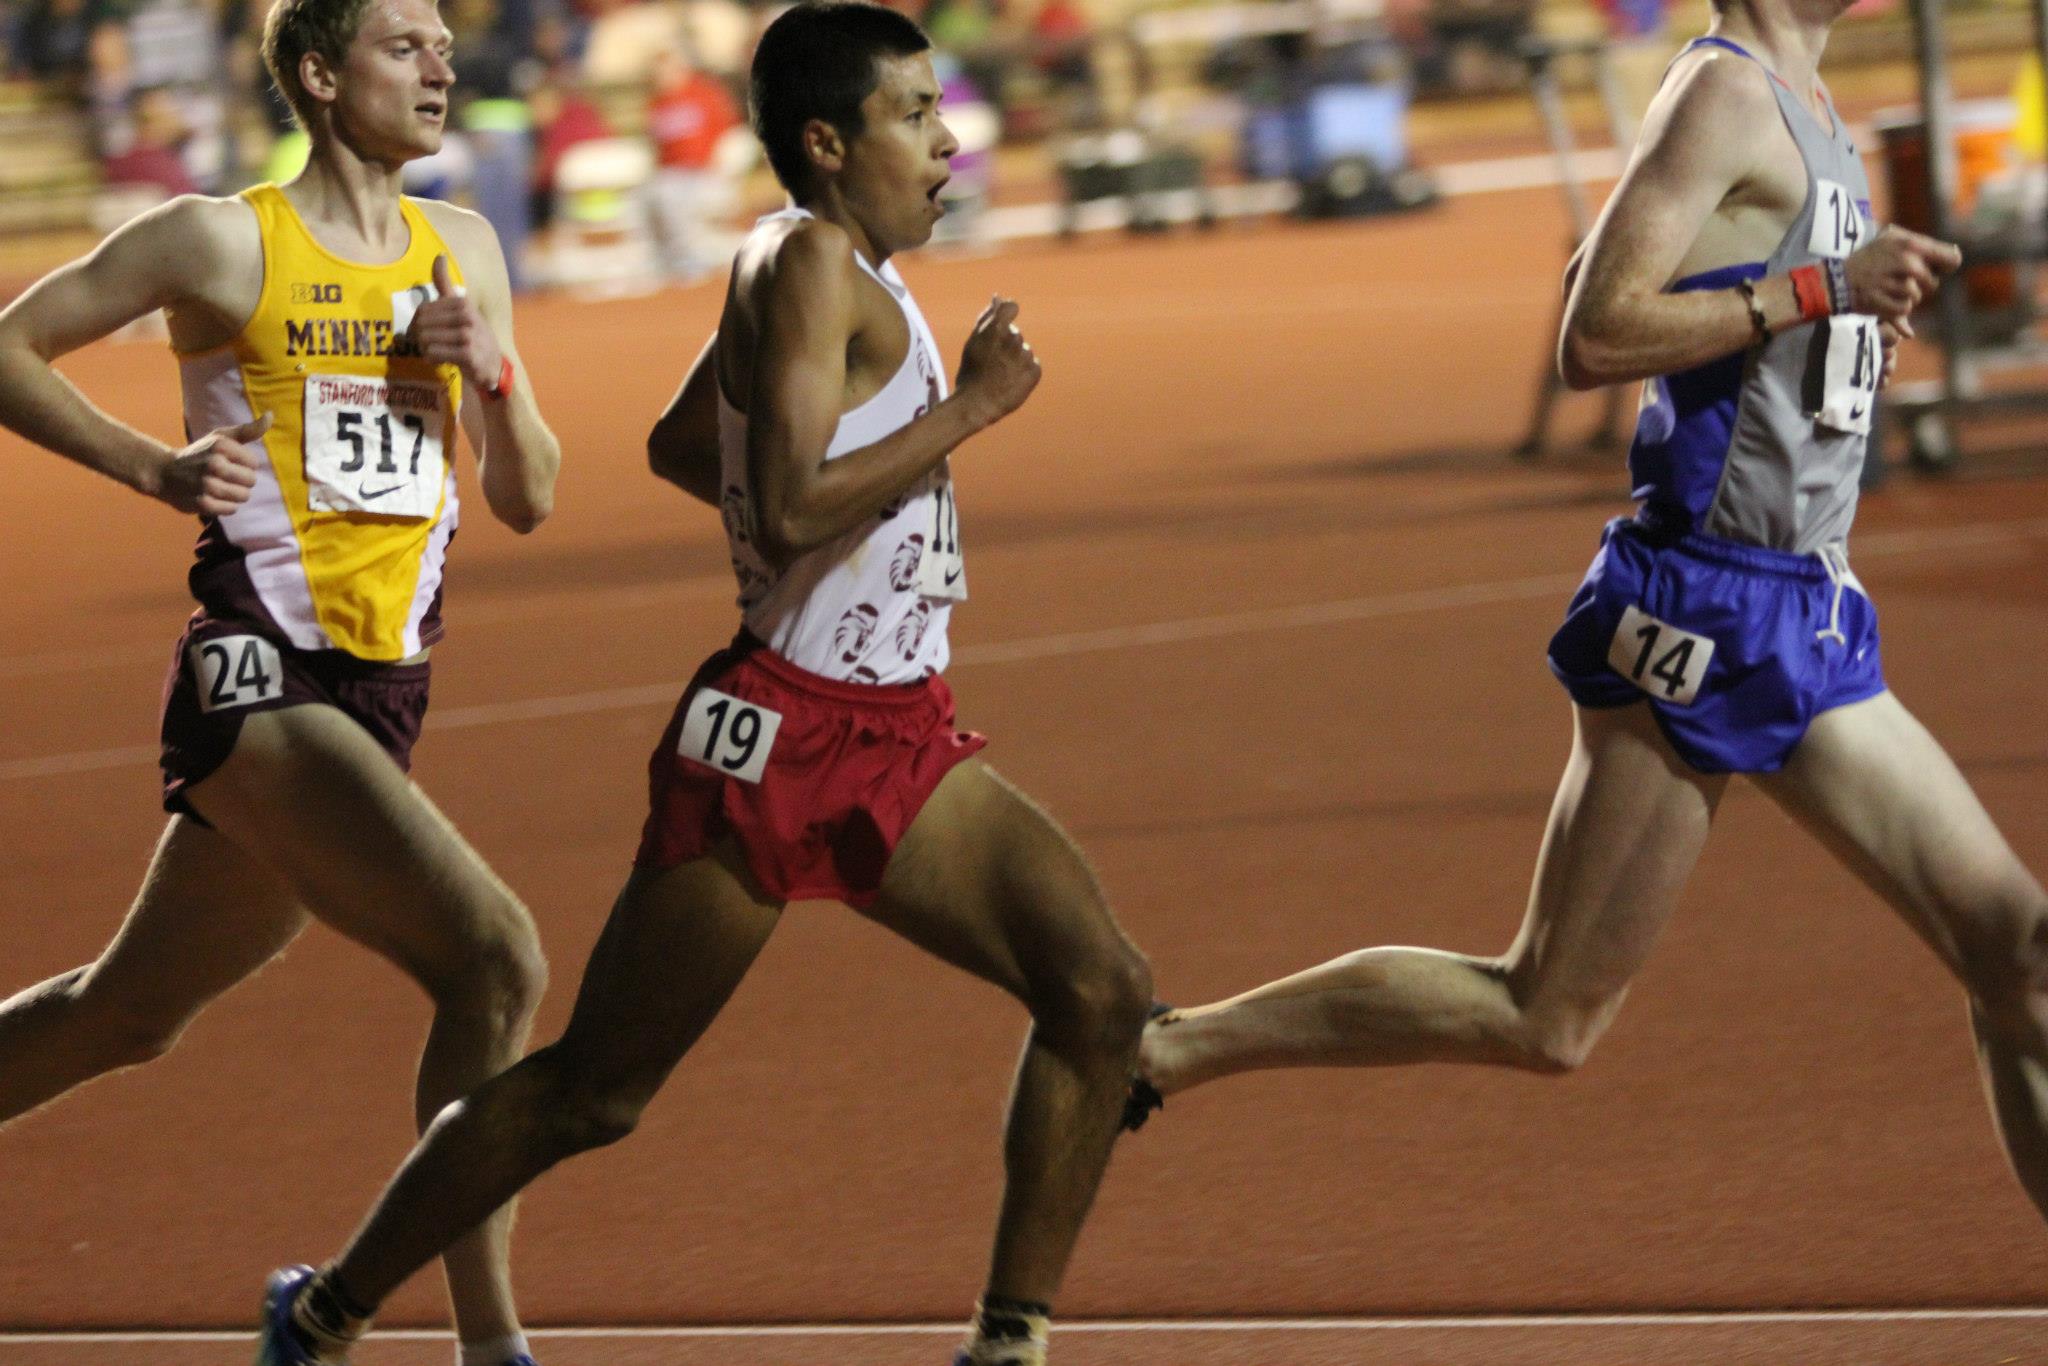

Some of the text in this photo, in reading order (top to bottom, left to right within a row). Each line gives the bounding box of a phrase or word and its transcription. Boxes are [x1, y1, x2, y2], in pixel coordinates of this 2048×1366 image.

[1829, 187, 1859, 255] 14
[286, 319, 422, 356] MINNE
[319, 382, 375, 406] STANFORD
[337, 411, 425, 475] 517
[201, 640, 271, 706] 24
[1631, 624, 1696, 697] 14
[703, 699, 762, 770] 19
